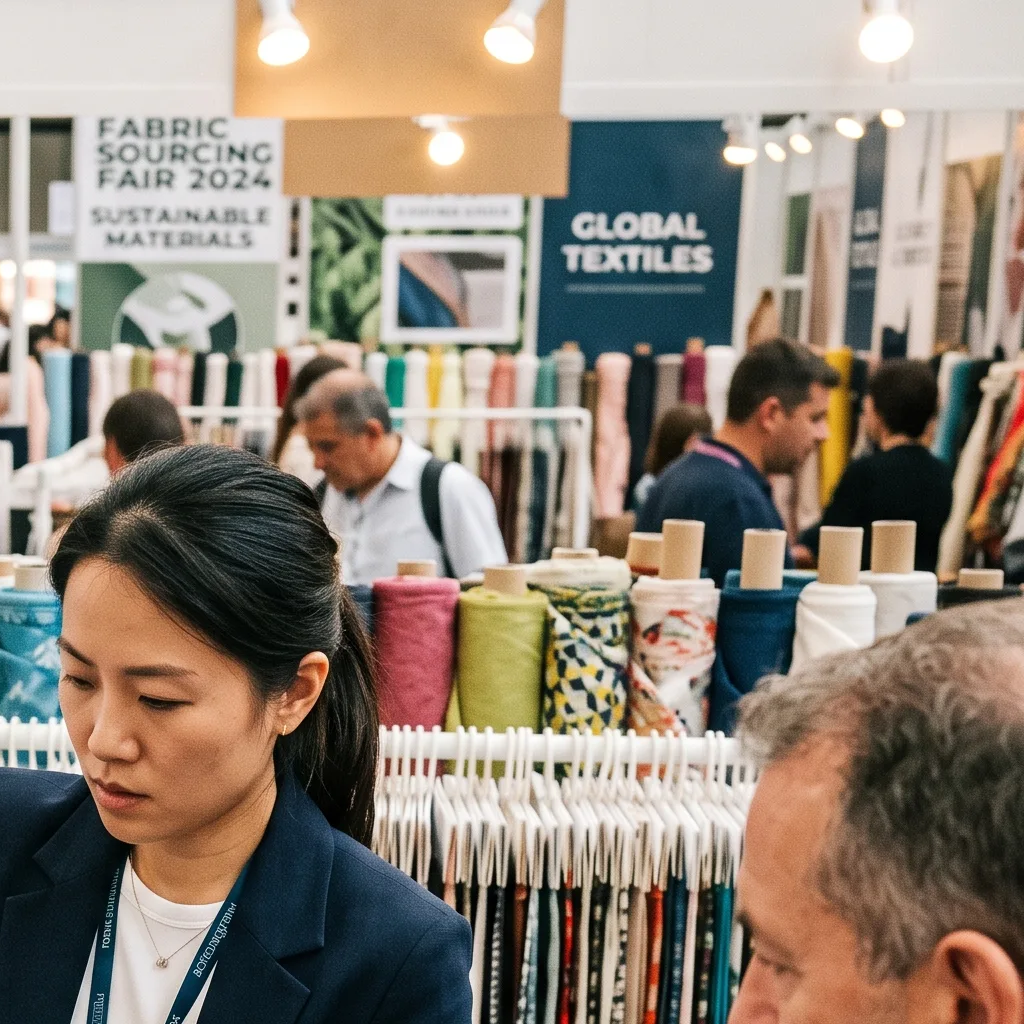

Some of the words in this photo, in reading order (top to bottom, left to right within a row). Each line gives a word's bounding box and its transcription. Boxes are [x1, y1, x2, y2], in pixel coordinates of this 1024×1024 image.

[98, 117, 228, 138] FABRIC
[97, 143, 272, 164] SOURCING
[98, 169, 175, 189] FAIR
[189, 169, 272, 189] 2024
[91, 207, 271, 225] SUSTAINABLE
[571, 211, 707, 240] GLOBAL
[105, 231, 254, 249] MATERIALS
[560, 244, 714, 273] TEXTILES
